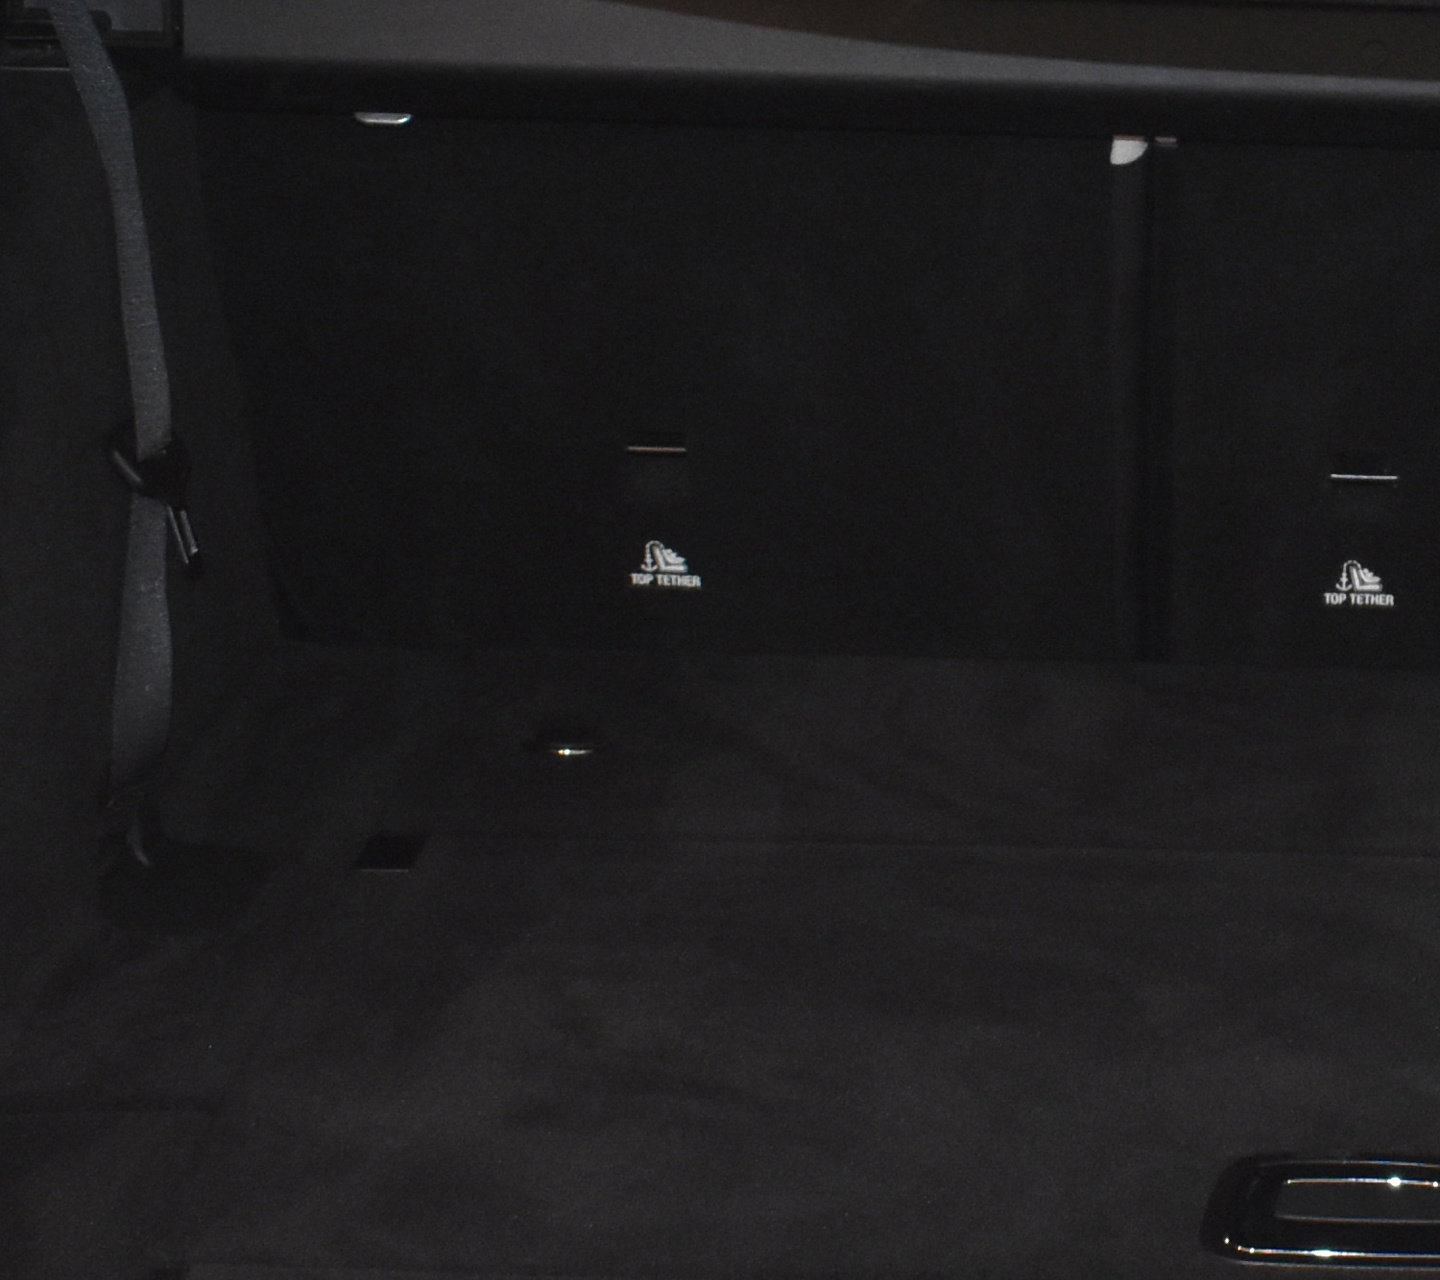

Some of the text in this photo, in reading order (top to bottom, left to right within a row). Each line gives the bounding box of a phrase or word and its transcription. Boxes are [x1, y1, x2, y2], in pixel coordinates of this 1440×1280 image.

[630, 573, 701, 588] TOP TETHER
[1324, 593, 1394, 607] TOP TETHER
